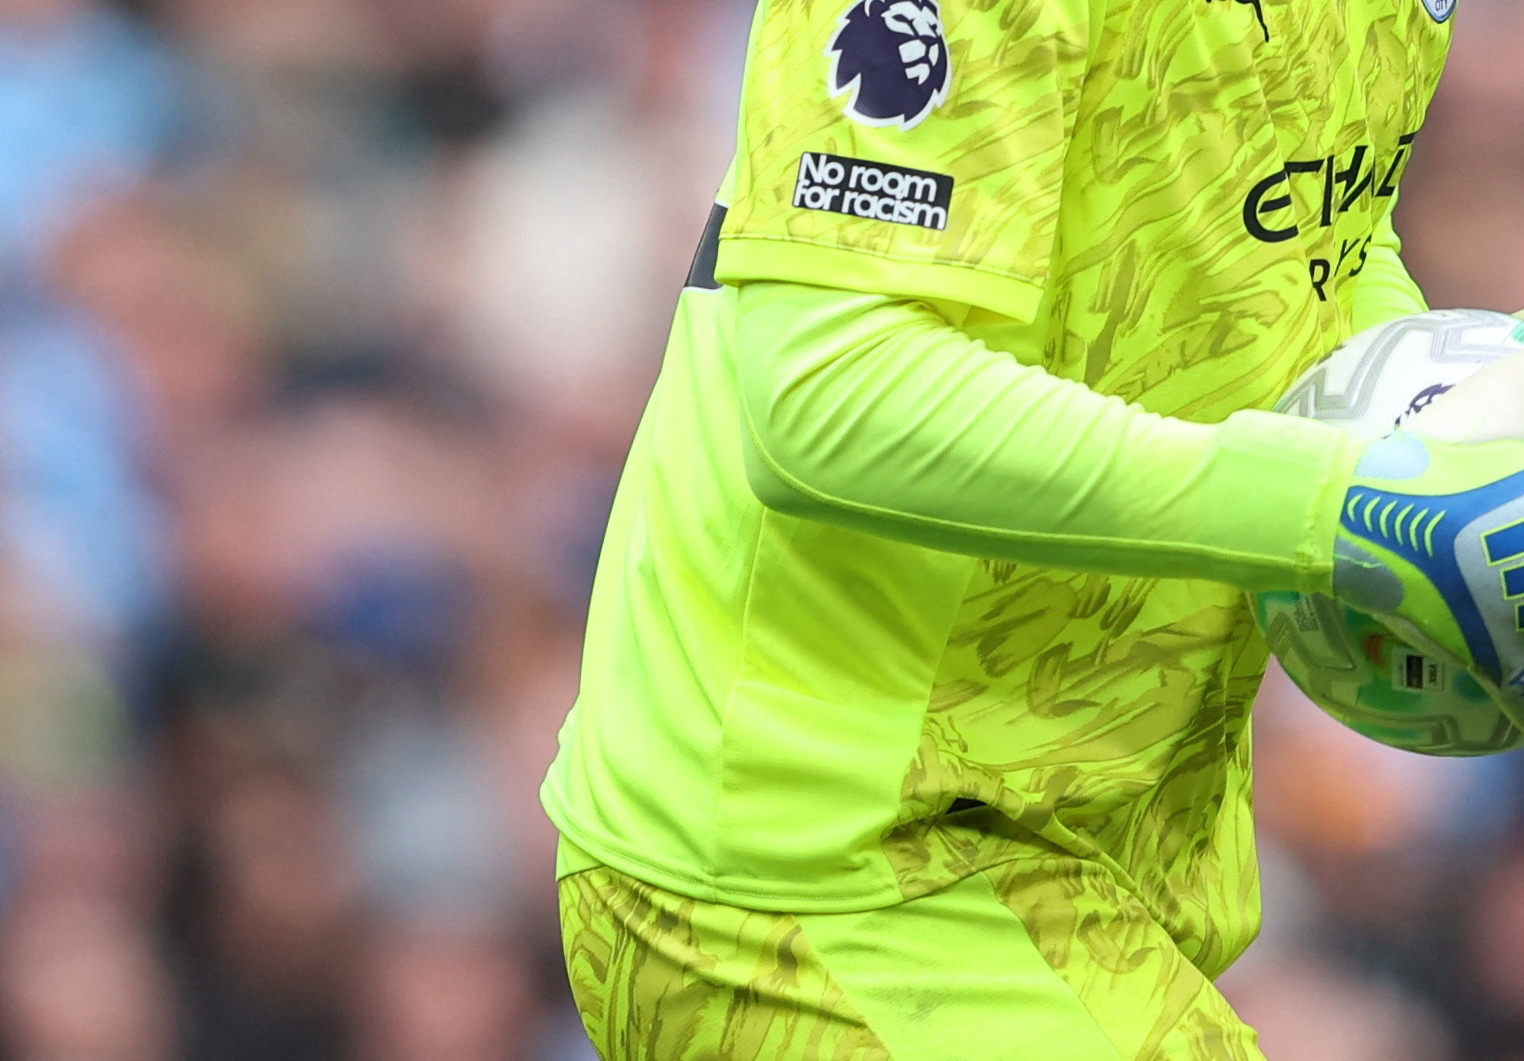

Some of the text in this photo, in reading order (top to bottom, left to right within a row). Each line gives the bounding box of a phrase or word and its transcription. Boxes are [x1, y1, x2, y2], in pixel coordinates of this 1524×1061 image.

[798, 152, 937, 203] No room
[793, 178, 947, 230] for racism
